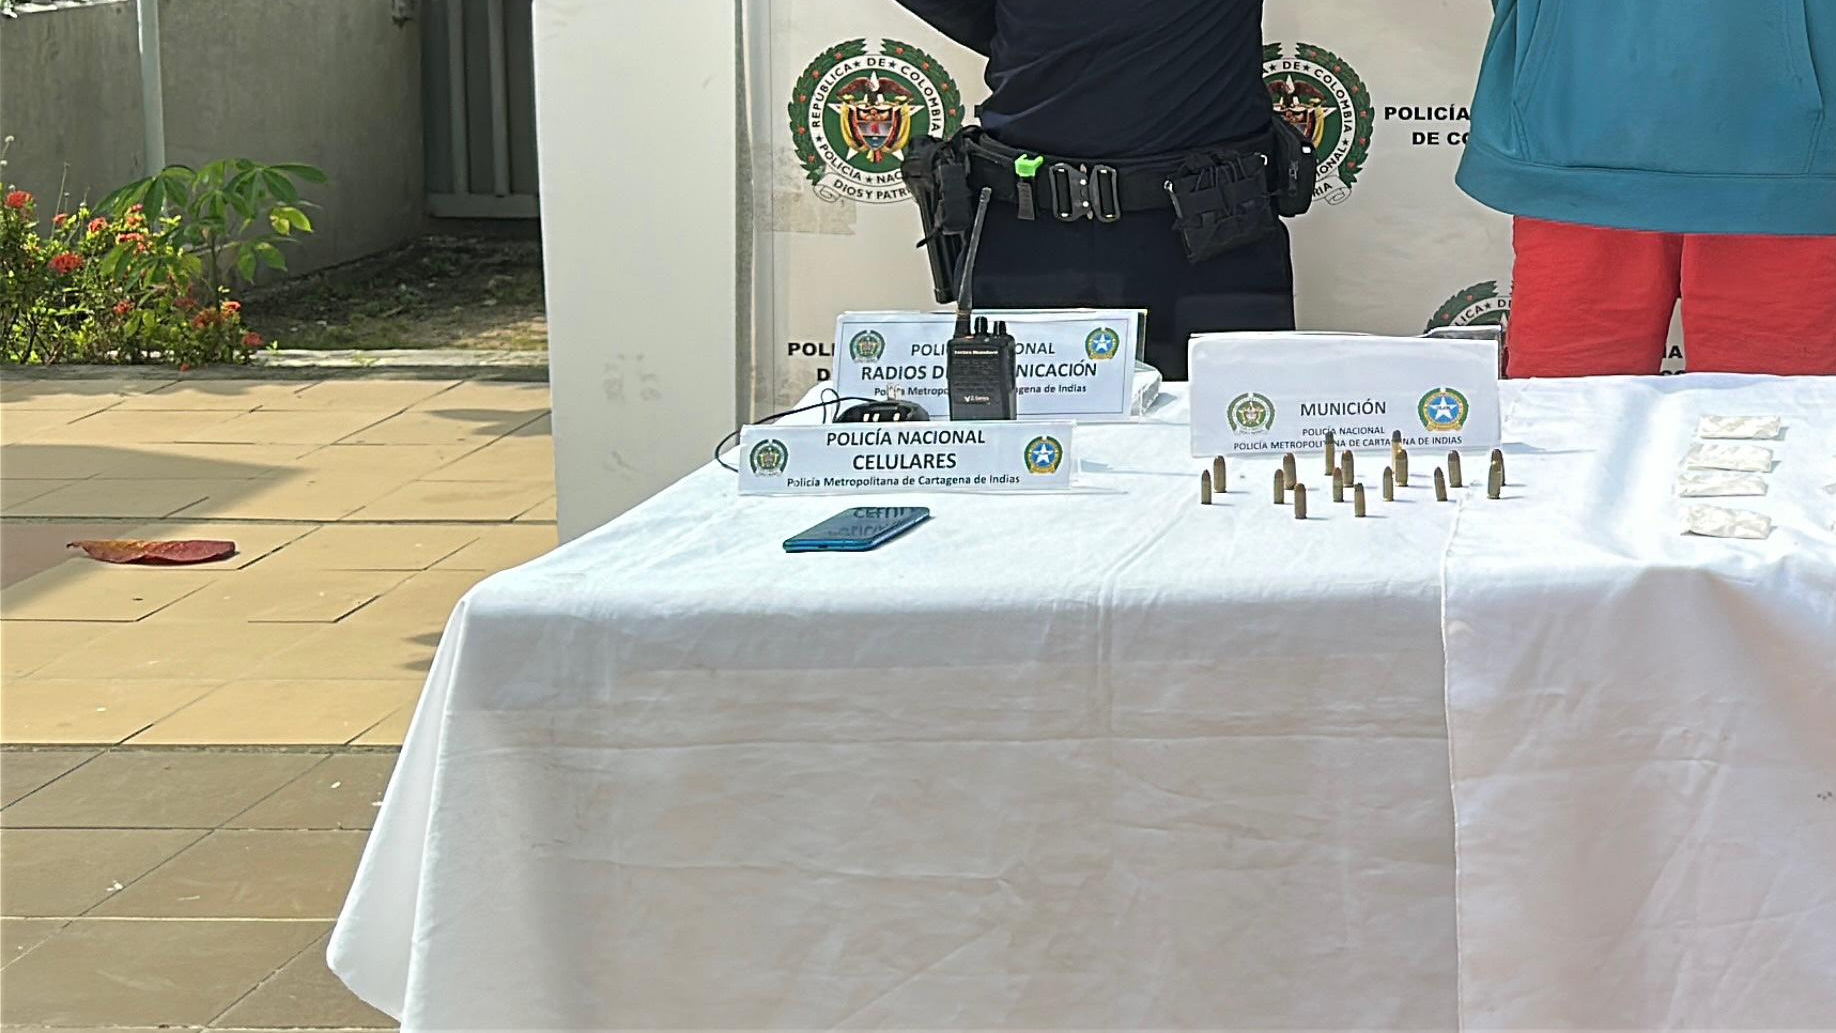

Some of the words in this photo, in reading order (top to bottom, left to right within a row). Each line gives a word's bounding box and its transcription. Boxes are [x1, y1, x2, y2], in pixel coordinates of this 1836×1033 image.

[1384, 105, 1474, 123] POLICÍA
[1412, 131, 1440, 146] DE
[787, 342, 831, 357] POLI
[910, 343, 945, 357] POLI
[1015, 342, 1056, 355] ONAL
[861, 365, 927, 381] RADIOS
[932, 364, 946, 380] D
[1015, 358, 1097, 378] NICACIÓN
[907, 384, 950, 398] Metropo
[1043, 384, 1056, 393] de
[1058, 383, 1087, 393] Indias
[1300, 398, 1386, 417] MUNICIÓN
[826, 427, 893, 447] POLICÍA
[897, 429, 986, 445] NACIONAL
[1339, 426, 1385, 435] NACIONAL
[1233, 441, 1268, 451] POLICÍA
[1270, 439, 1346, 449] METROPOLINA
[1348, 438, 1360, 447] DE
[1362, 437, 1416, 448] CARTANA
[1417, 436, 1429, 446] DE
[1432, 436, 1463, 445] INDIAS
[852, 452, 957, 471] CELULARES
[787, 477, 821, 488] Policía
[823, 476, 899, 488] Metropolitana
[902, 475, 916, 486] de
[917, 475, 971, 487] Cartagena
[973, 474, 987, 485] de
[989, 473, 1020, 484] Indias
